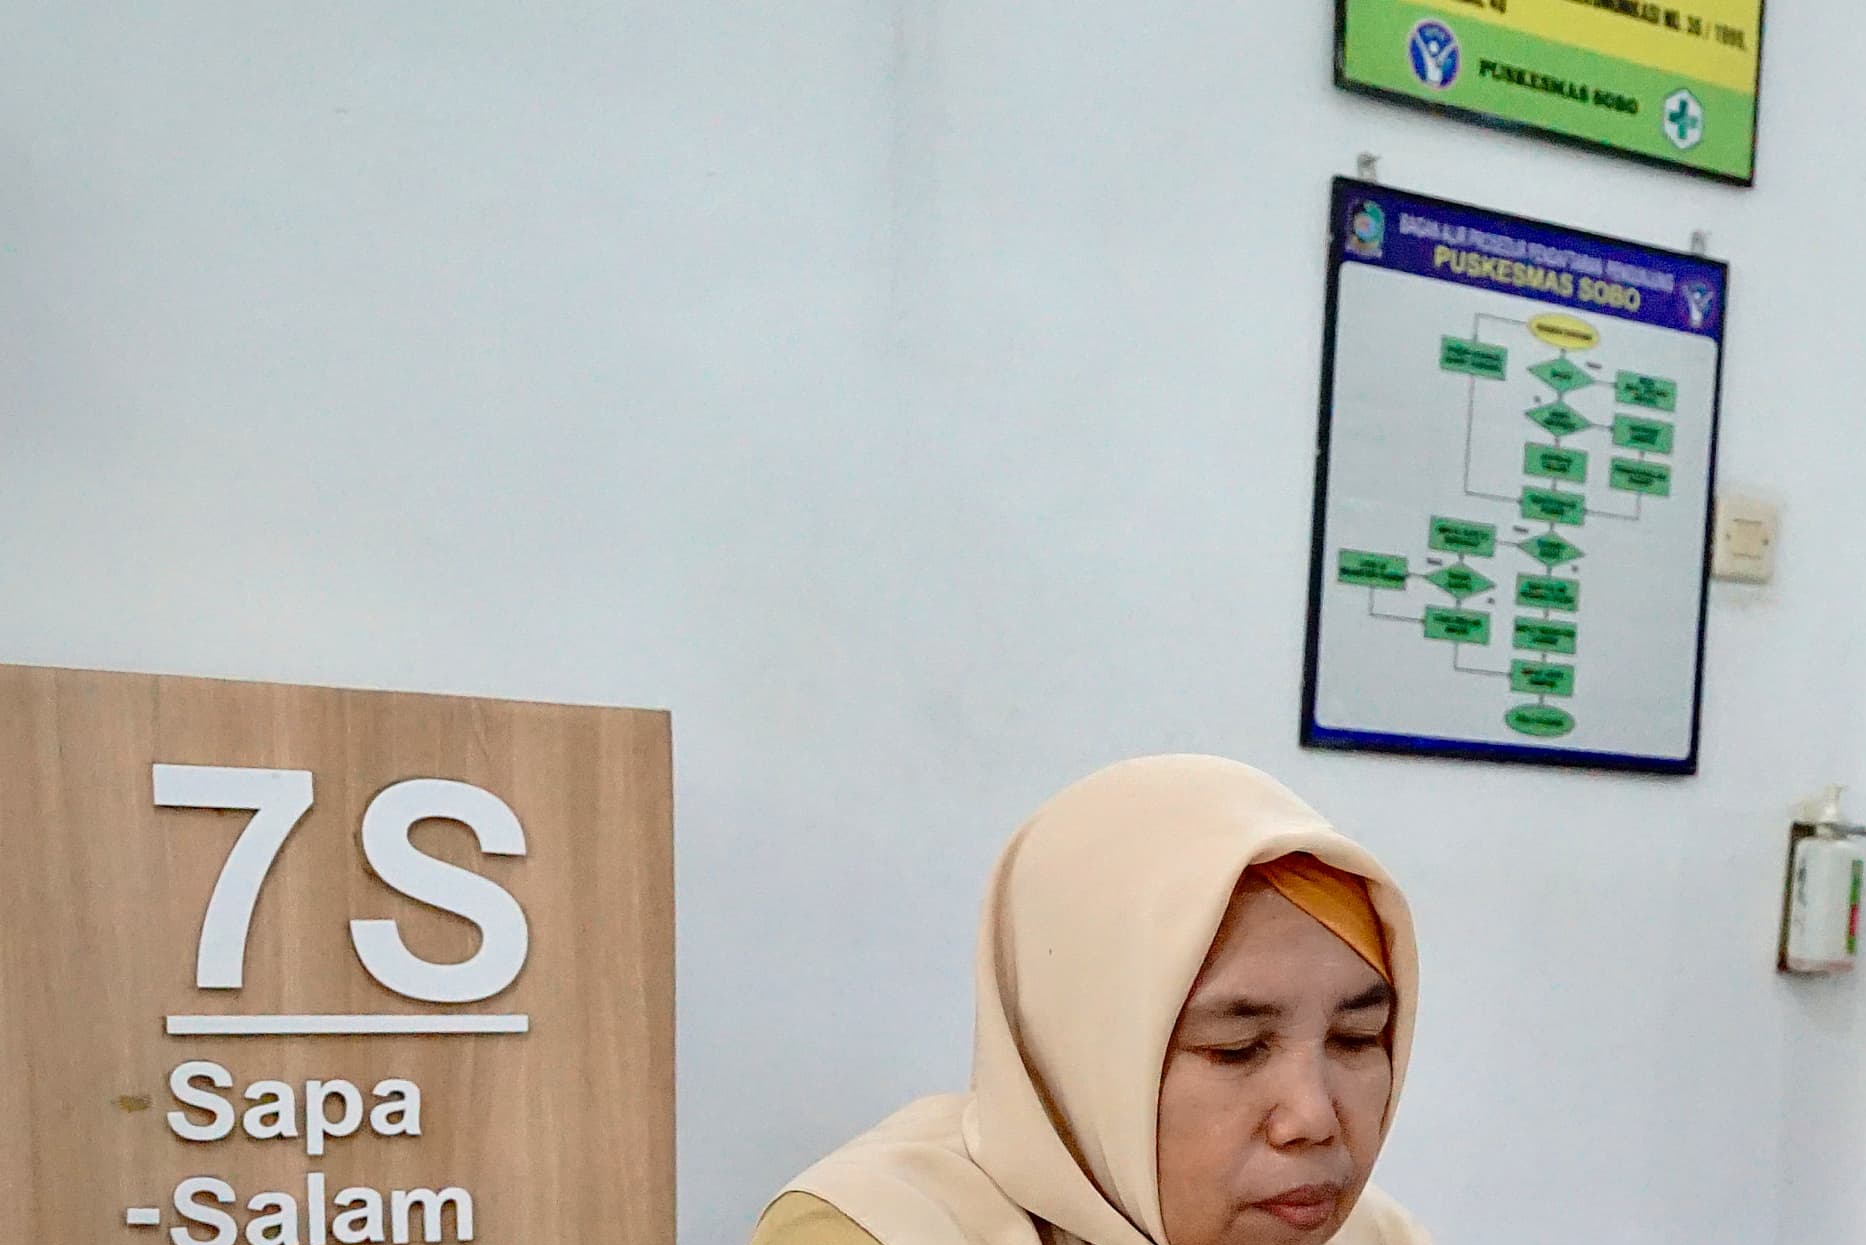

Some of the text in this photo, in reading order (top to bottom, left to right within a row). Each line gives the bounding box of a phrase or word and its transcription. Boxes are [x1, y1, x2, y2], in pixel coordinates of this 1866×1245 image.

[1479, 57, 1589, 104] PUSKESMAS
[1433, 244, 1641, 313] PUSKESMAS SOBO
[152, 762, 529, 1003] 7S
[166, 1060, 422, 1156] Sapa
